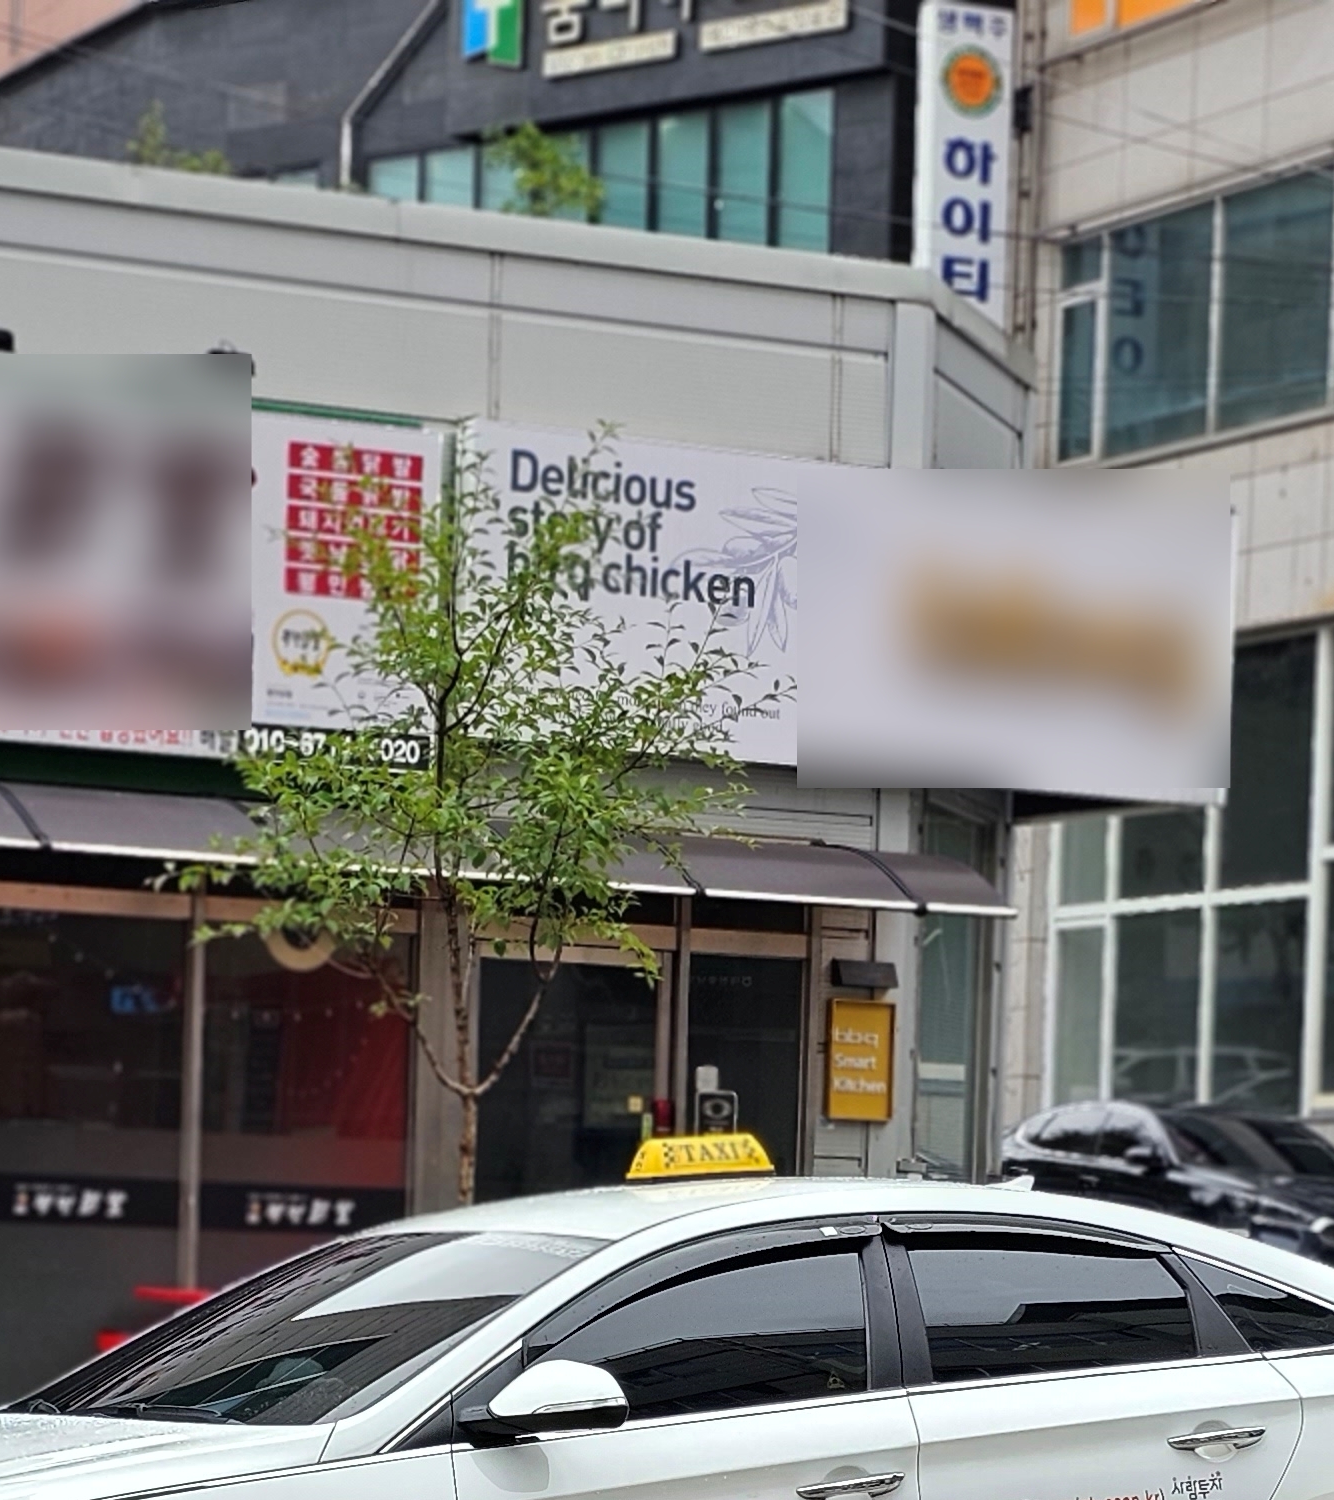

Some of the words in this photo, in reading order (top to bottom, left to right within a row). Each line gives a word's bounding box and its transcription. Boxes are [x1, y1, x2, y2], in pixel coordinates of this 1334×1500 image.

[511, 448, 696, 513] Delicious
[508, 500, 615, 554] sty
[623, 511, 663, 553] of
[507, 540, 591, 602] bq
[601, 554, 756, 608] chicken
[835, 1053, 877, 1070] Smart
[834, 1077, 886, 1094] Kitchen
[682, 1142, 740, 1163] TAXI
[1171, 1471, 1223, 1500] 사람투자
